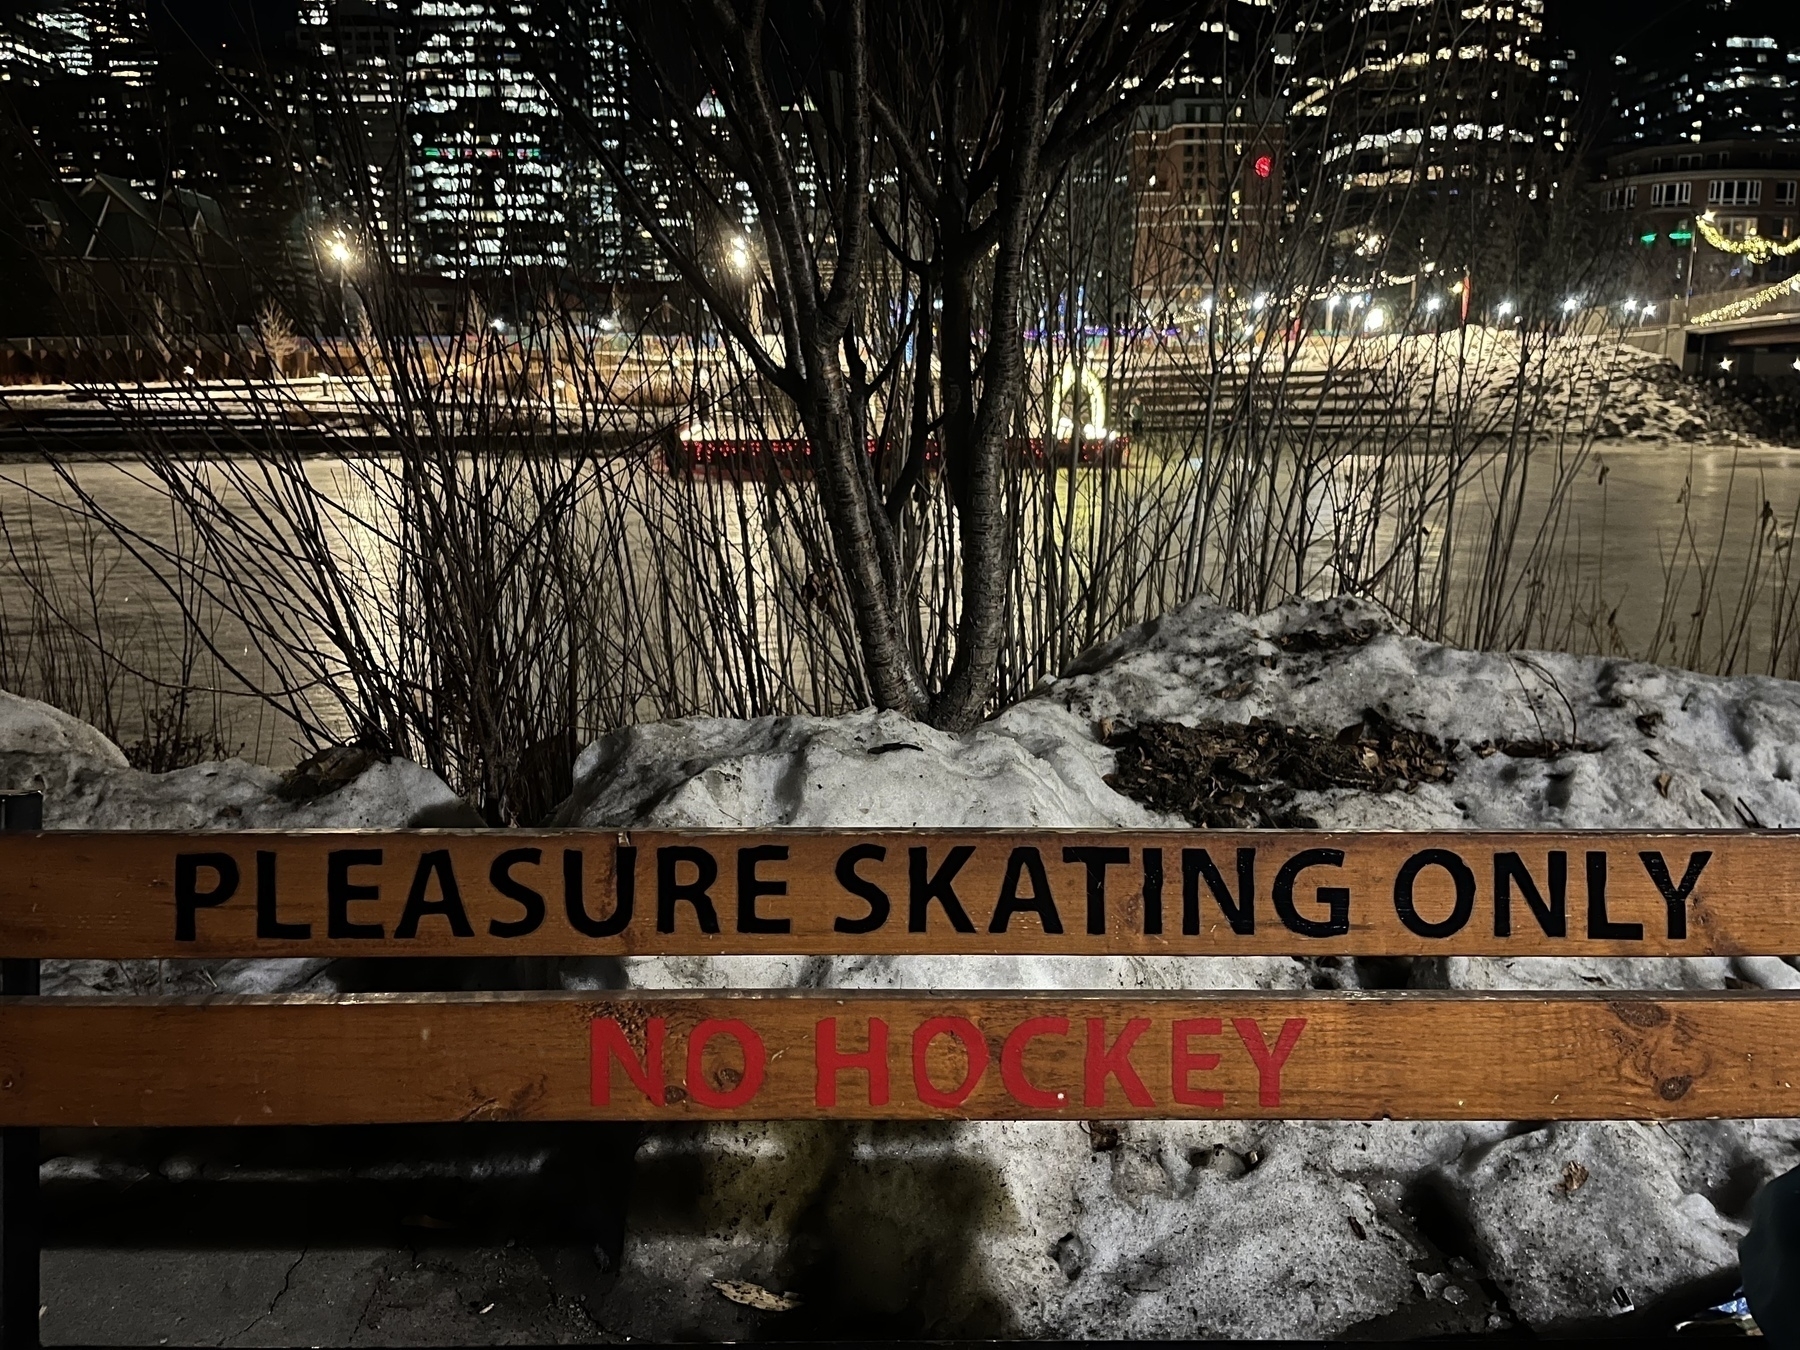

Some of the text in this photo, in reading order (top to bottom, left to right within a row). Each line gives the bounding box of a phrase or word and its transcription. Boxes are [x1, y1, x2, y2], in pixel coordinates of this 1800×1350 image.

[174, 843, 1713, 942] PLEASURE SKATING ONLY
[590, 1016, 1308, 1108] NO HOCKEY
